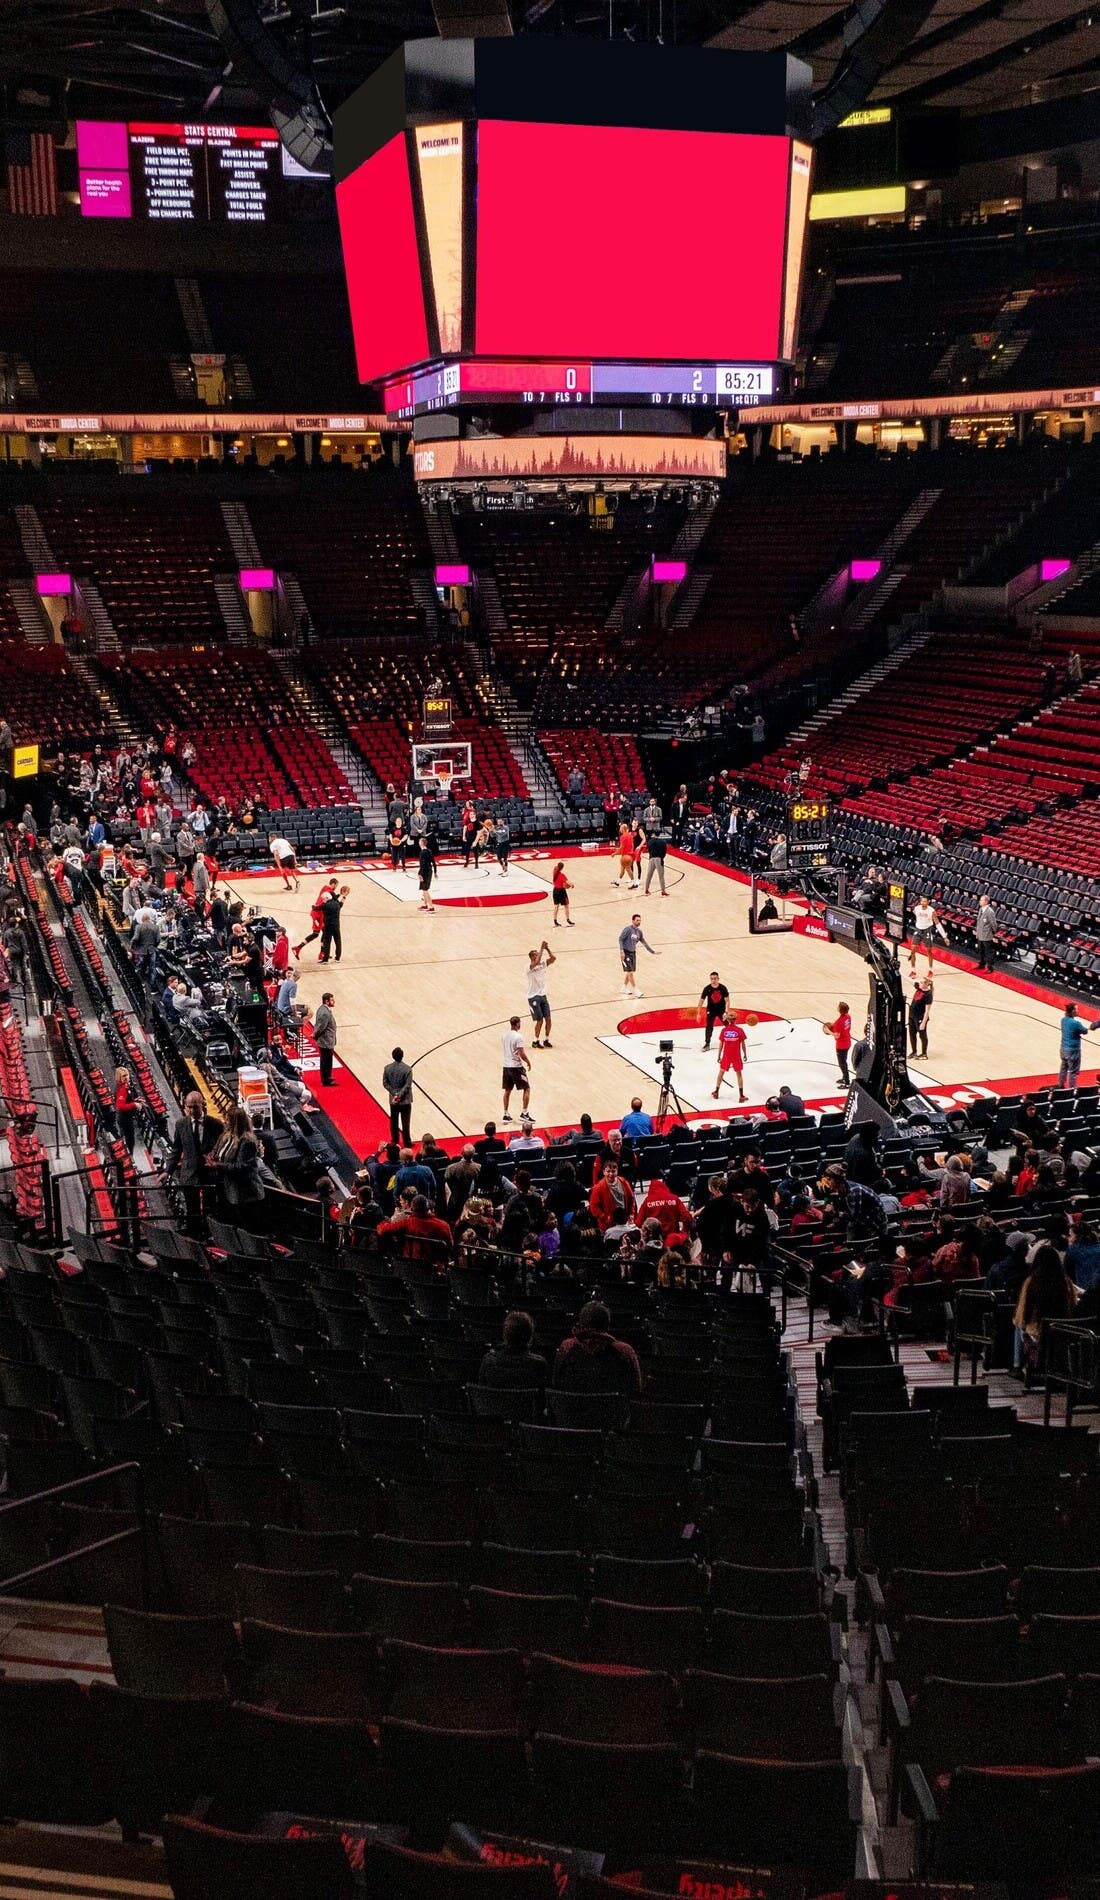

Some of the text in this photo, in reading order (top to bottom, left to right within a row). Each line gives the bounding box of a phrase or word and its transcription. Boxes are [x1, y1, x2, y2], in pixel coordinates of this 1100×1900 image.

[184, 125, 237, 138] STATS CENTRAL
[421, 137, 458, 148] WELCOME TO
[146, 146, 162, 155] FIELD
[145, 156, 159, 165] FREE
[220, 159, 233, 168] FAST
[145, 167, 158, 175] FREE
[234, 170, 255, 179] ASSISTS
[230, 181, 260, 189] TURNOVERS
[162, 199, 191, 208] REBOUNDS
[230, 201, 263, 210] TOTAL FOULS
[160, 210, 181, 218] CHANCE
[227, 211, 265, 220] BENCH POINTS
[566, 368, 576, 390] 0
[693, 370, 702, 391] 2
[725, 372, 761, 390] 85:21
[523, 392, 582, 402] TO 7 FLS 0
[652, 393, 708, 404] TO 7 FLS 0
[427, 702, 448, 711] 85:21
[793, 805, 828, 819] 85:21
[802, 843, 829, 851] TISSOT
[647, 1200, 665, 1208] CREW
